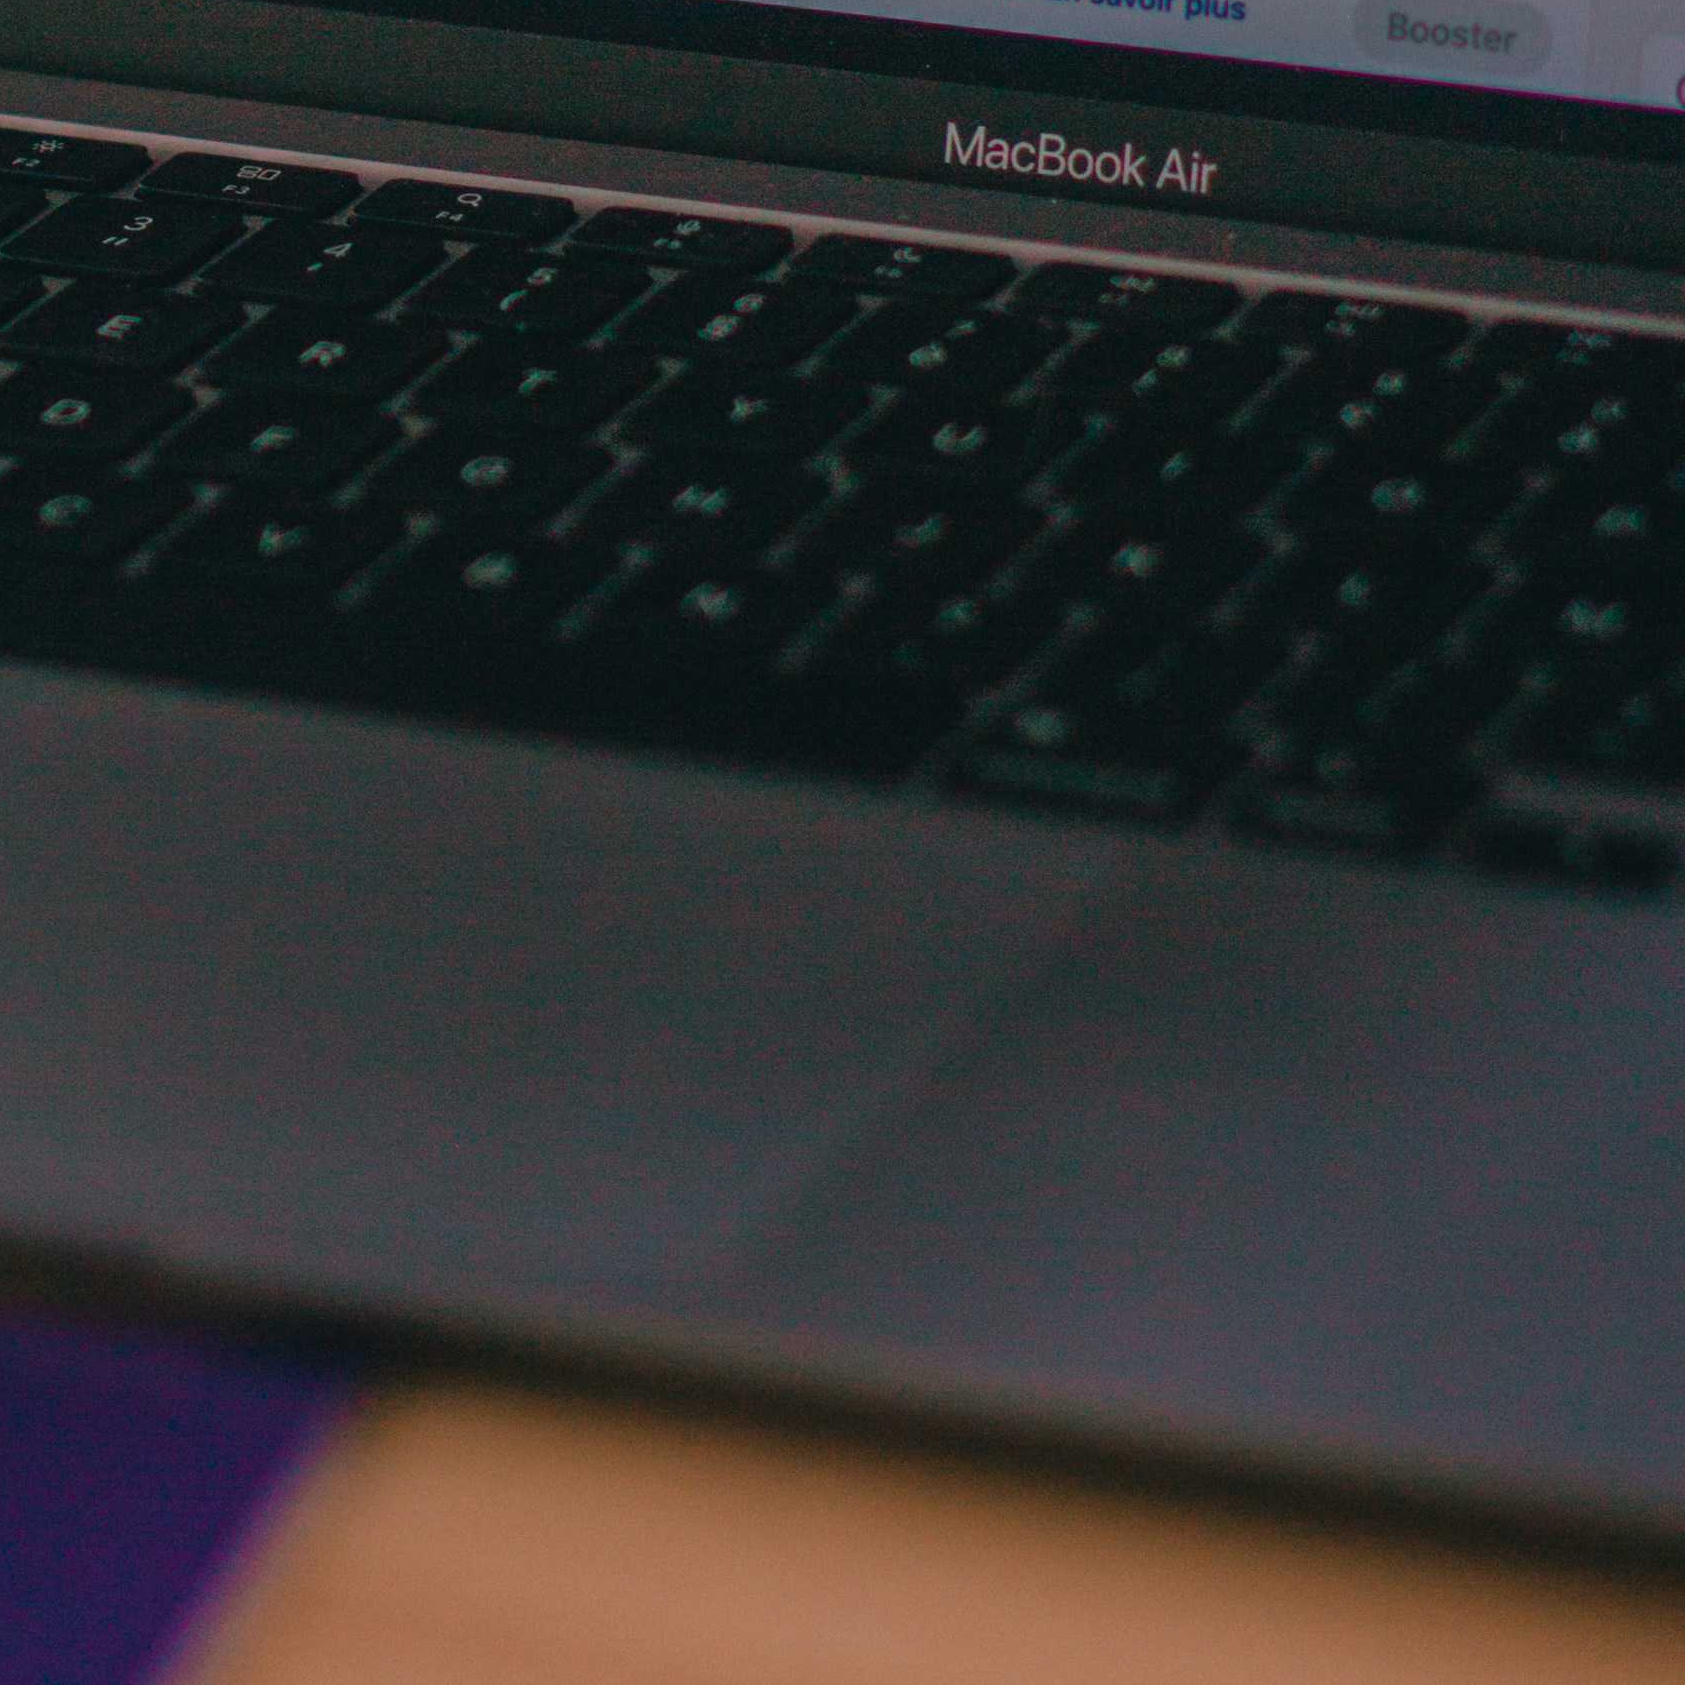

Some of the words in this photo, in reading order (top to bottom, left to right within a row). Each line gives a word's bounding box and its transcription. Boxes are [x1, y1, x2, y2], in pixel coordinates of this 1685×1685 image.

[1386, 11, 1517, 55] Booster
[942, 122, 1146, 187] MacBook
[1156, 147, 1216, 195] Air
